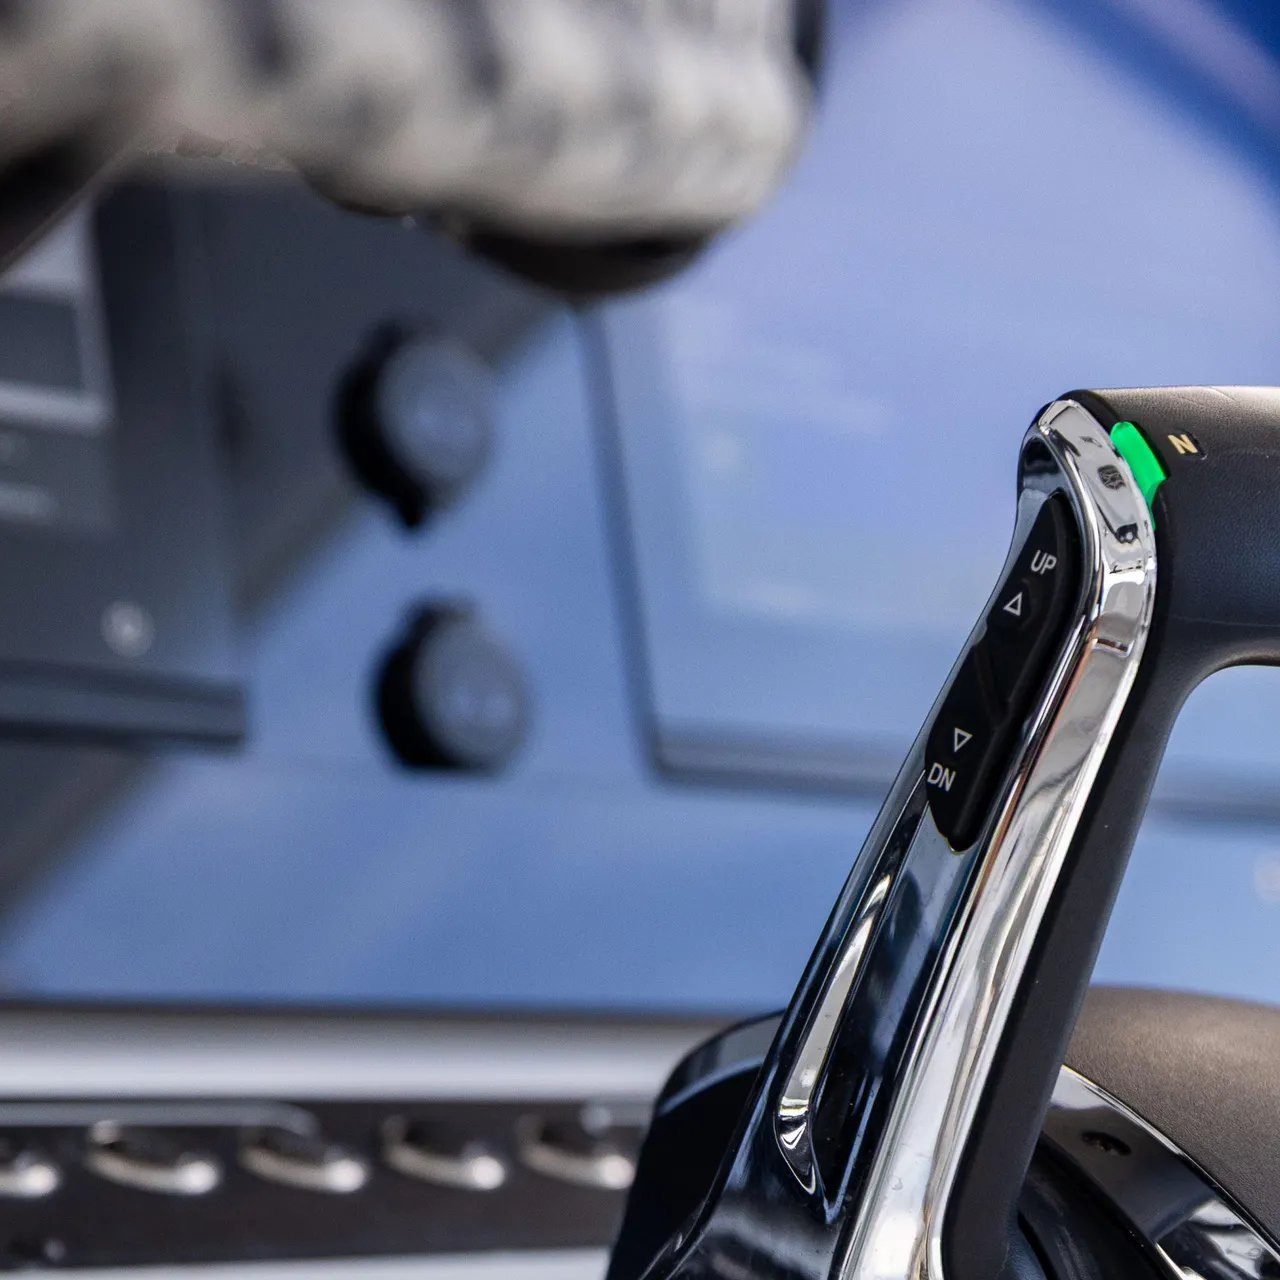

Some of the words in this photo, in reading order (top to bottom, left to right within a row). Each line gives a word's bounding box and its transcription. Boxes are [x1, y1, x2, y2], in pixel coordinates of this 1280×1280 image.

[1167, 434, 1199, 454] N
[1030, 549, 1057, 575] UP
[927, 762, 957, 792] DN
